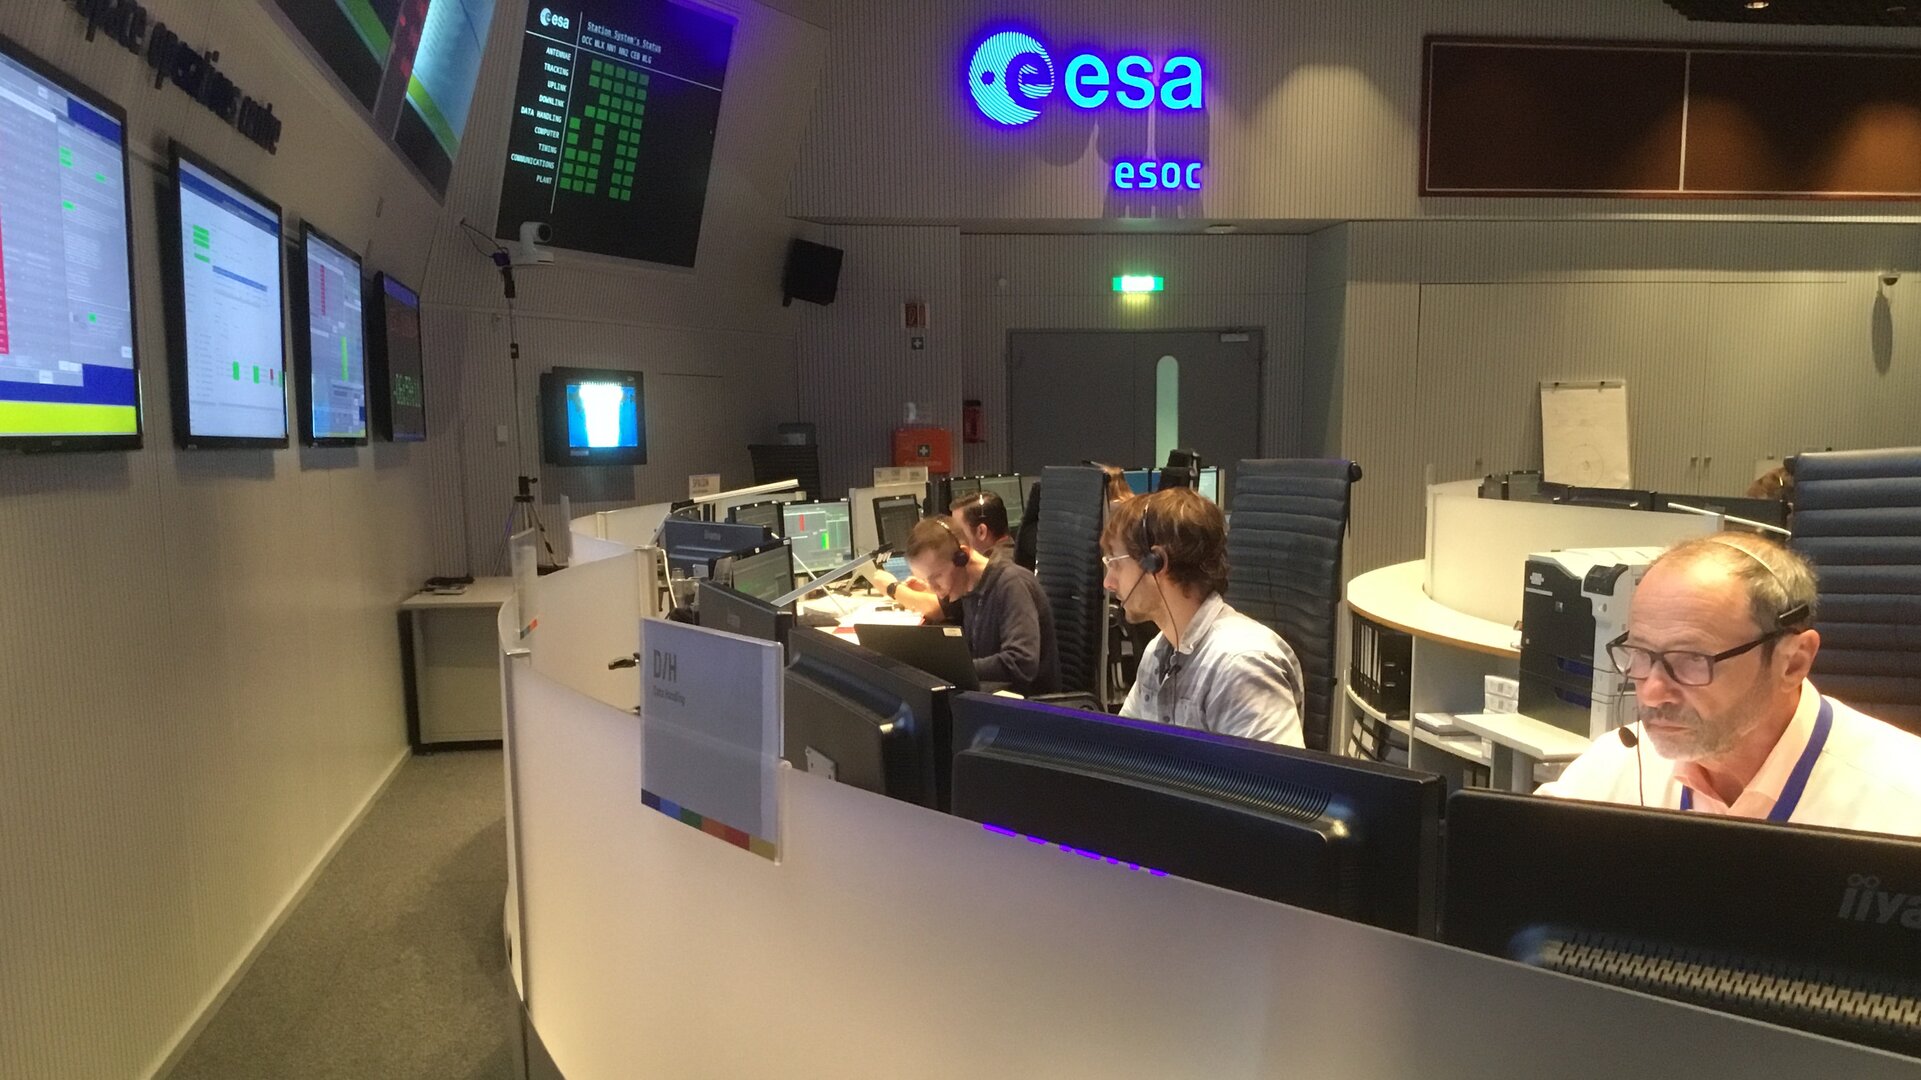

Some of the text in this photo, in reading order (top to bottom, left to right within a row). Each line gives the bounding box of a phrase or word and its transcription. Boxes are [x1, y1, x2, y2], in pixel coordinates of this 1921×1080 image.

[551, 14, 570, 30] esa
[587, 22, 612, 36] Station
[642, 40, 661, 53] Status
[544, 62, 569, 77] TRACKING
[547, 80, 567, 92] UPLINK
[1064, 53, 1203, 110] esa
[538, 94, 565, 108] DOWNLINK
[520, 105, 562, 124] DATA HANDLING
[534, 126, 560, 139] COMPUTER
[538, 142, 558, 154] TIMING
[510, 152, 555, 170] COMMUNICATIONS
[536, 174, 553, 185] PLANT
[1115, 161, 1201, 189] esoc
[653, 648, 678, 684] D/H
